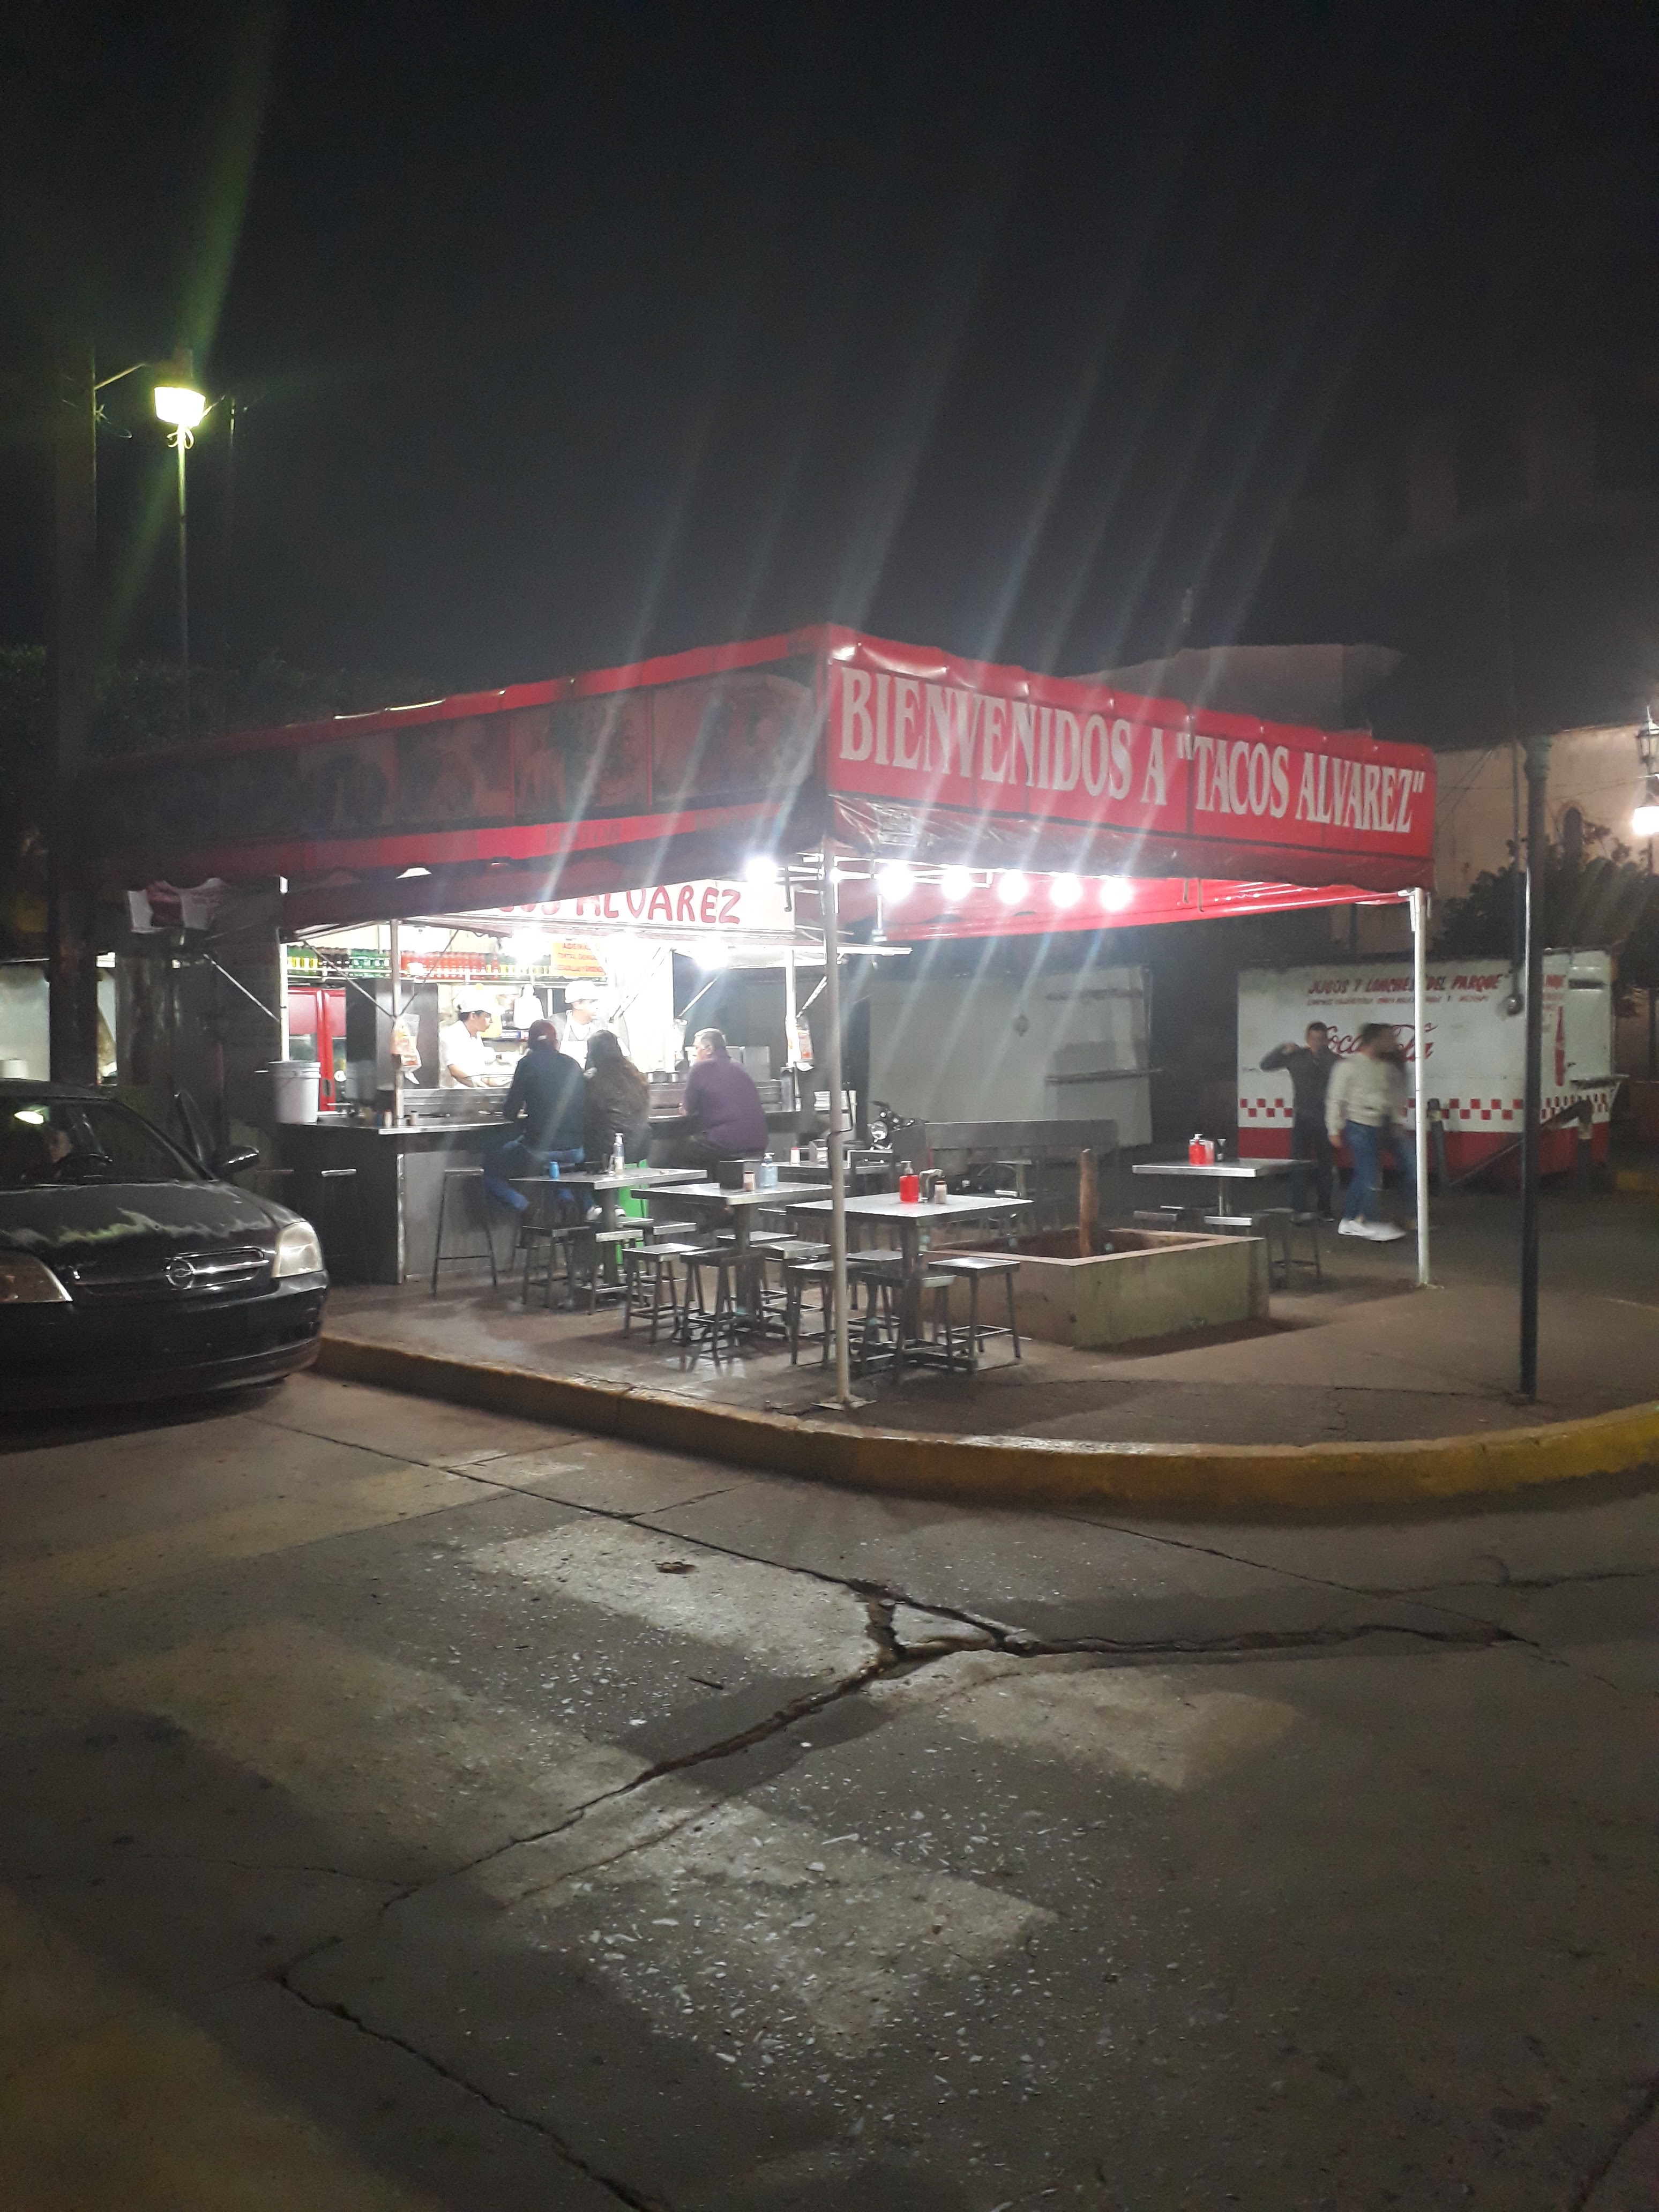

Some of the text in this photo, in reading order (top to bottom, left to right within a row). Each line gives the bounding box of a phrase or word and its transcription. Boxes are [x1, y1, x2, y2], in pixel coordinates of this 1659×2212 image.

[839, 666, 1426, 833] BIENVENIDOS A "TACOS ALVAREZ"
[576, 885, 741, 924] ALVAREZ
